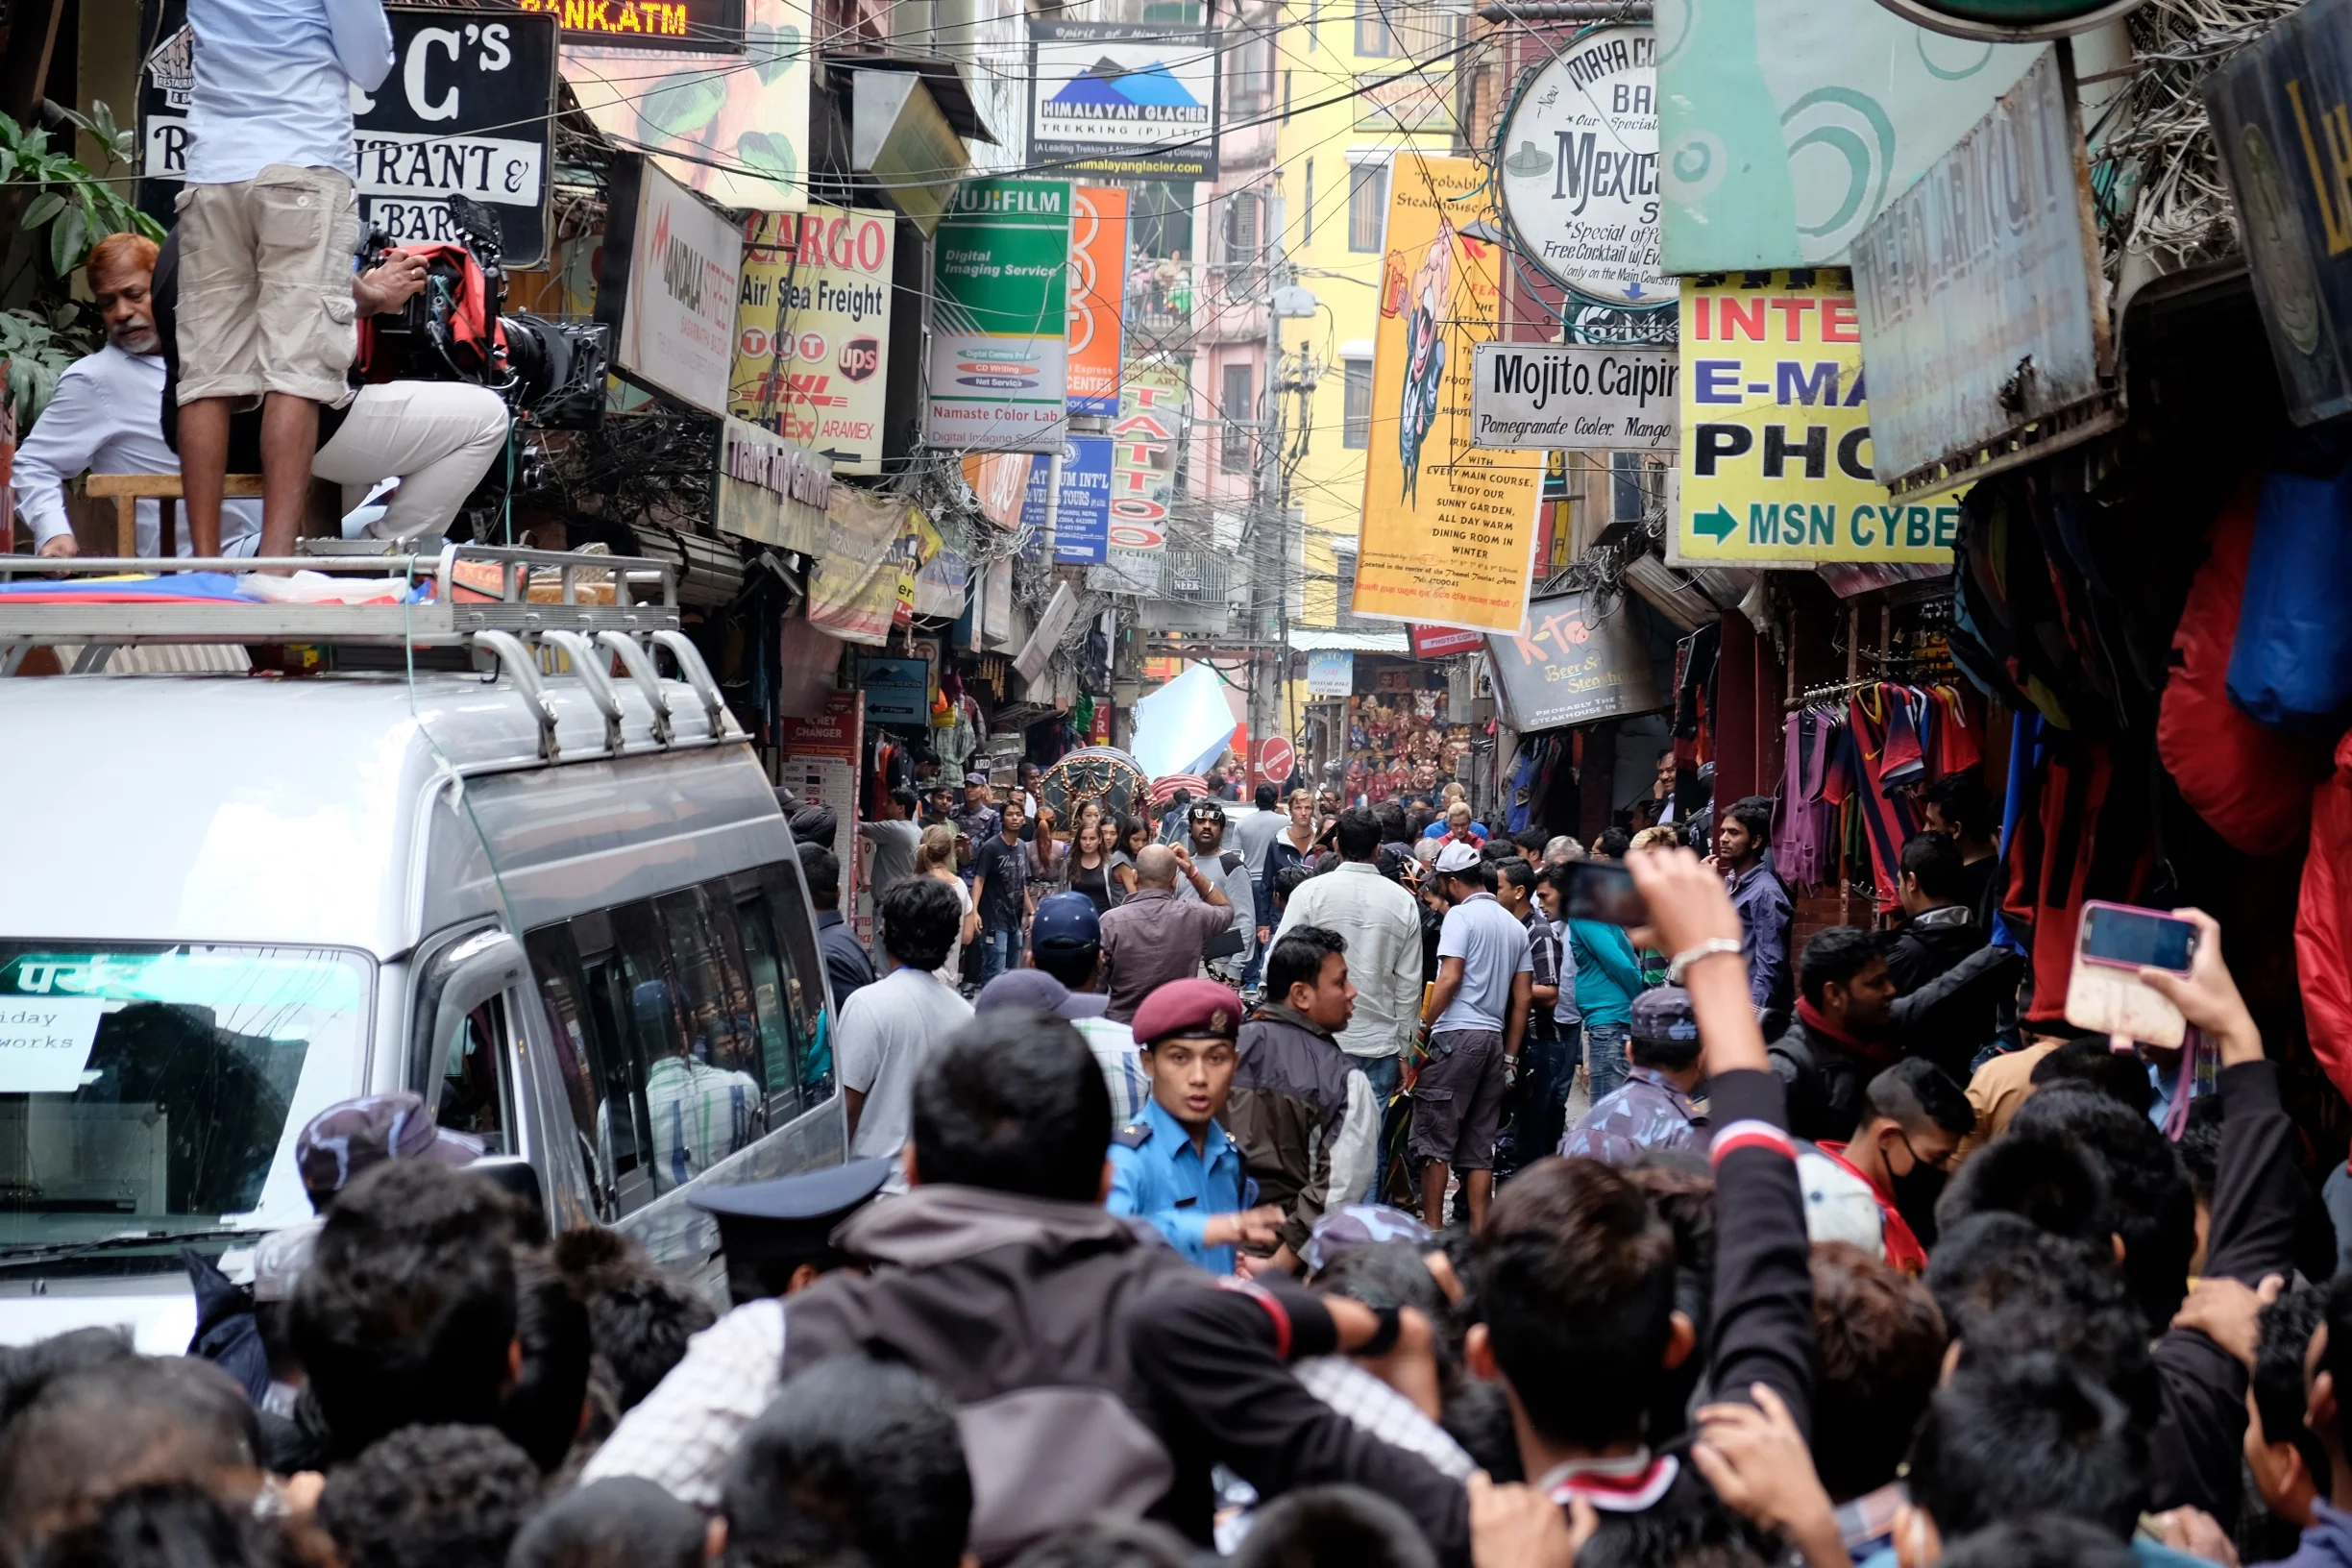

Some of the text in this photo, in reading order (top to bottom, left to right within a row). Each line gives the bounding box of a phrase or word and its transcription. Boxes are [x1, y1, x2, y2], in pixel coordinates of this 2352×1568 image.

[1566, 39, 1629, 92] MAYA
[1042, 101, 1208, 123] HIMALAYAN GLACIER
[1041, 123, 1202, 138] TREKKING (P) LTD
[1045, 142, 1074, 156] Leading
[1174, 147, 1213, 159] Company)
[1397, 192, 1480, 214] Steakhouse
[746, 208, 887, 273] CARGO
[945, 250, 992, 263] Digital
[1576, 242, 1628, 264] Cocktail
[944, 263, 1058, 279] Imaging Service
[1589, 268, 1600, 279] on
[1601, 266, 1616, 280] the
[1618, 269, 1640, 282] Main
[777, 276, 812, 311] Sea
[818, 280, 883, 323] Freight
[838, 347, 877, 378] ups
[990, 365, 1020, 375] Writing
[1074, 363, 1115, 376] Express
[754, 371, 834, 407] DHL
[975, 378, 1023, 388] Net Service
[1154, 376, 1178, 386] ART
[1494, 354, 1594, 410] Mojito.
[933, 406, 1058, 423] Namaste Color Lab
[821, 420, 875, 441] ARAMEX
[933, 431, 1057, 446] Digital Imaging Service
[1481, 414, 1569, 444] Pomegranate
[1624, 416, 1672, 447] Mango
[1105, 384, 1175, 551] TATTOO
[1468, 455, 1495, 467] WITH
[1427, 465, 1534, 488] EVERY MAIN COURSE.
[1063, 490, 1090, 506] TOURS
[1450, 483, 1506, 500] ENJOY OUR
[1436, 498, 1516, 517] SUNNY GARDEN,
[1438, 513, 1513, 531] ALL DAY WARM
[1749, 502, 1837, 546] MSN
[1433, 527, 1514, 547] DINING ROOM IN
[1452, 545, 1489, 559] WINTER
[1360, 560, 1386, 570] Located
[1445, 569, 1471, 578] Thamel
[1471, 573, 1495, 582] Tourist
[1496, 576, 1517, 586] Area
[1430, 632, 1478, 647] PHOTO COPY
[1544, 663, 1581, 683] Beer
[1529, 706, 1604, 726] STEAKHOUSE
[1535, 700, 1592, 717] PROBABLY
[1594, 696, 1616, 706] THE
[796, 726, 844, 739] CHANGER
